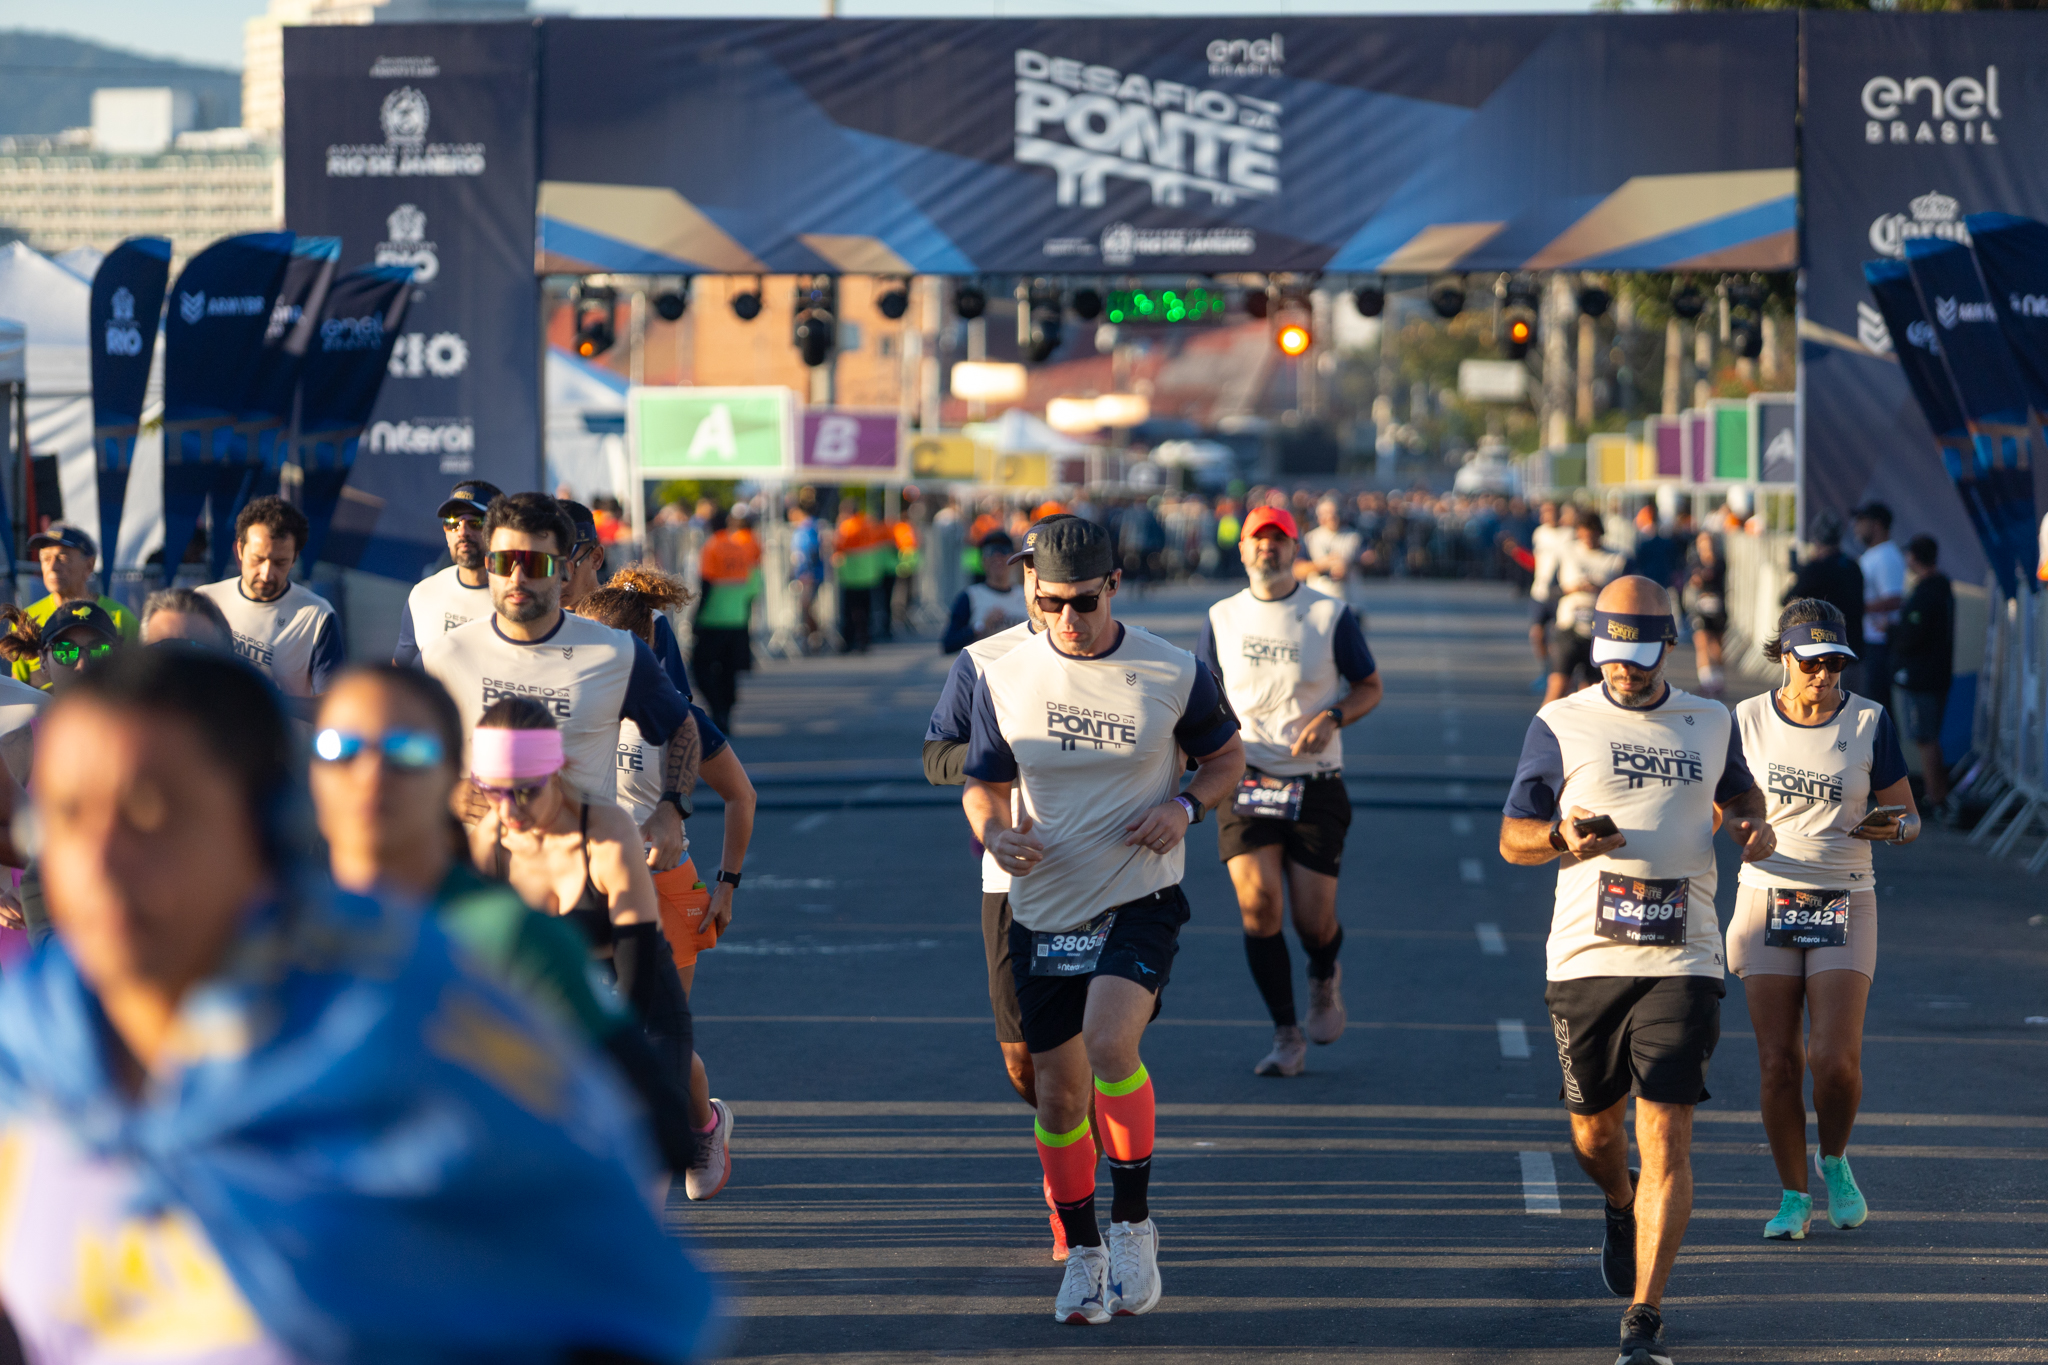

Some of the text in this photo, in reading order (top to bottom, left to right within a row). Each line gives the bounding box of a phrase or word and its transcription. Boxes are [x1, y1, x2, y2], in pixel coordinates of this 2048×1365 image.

[1207, 33, 1285, 64] enel
[1015, 48, 1239, 122] DESAFIO
[1861, 64, 2002, 121] enel
[1014, 78, 1284, 194] PONTE
[1865, 120, 1998, 145] BRASIL
[1868, 213, 1973, 260] Coron
[105, 327, 143, 357] RIO
[687, 402, 738, 462] A
[812, 414, 861, 463] B
[1608, 623, 1639, 640] PONTE
[1811, 631, 1838, 642] PONTE
[482, 677, 555, 697] DESAFIO
[1046, 701, 1120, 723] DESAFIO
[1047, 710, 1137, 745] PONTE
[1610, 742, 1687, 759] DESAFIO
[1612, 750, 1703, 782] PONTE
[1768, 762, 1843, 786] DESAFIO DA
[1768, 770, 1843, 803] PONTE
[1618, 900, 1674, 921] 3499
[1784, 909, 1835, 926] 3342
[1051, 934, 1098, 952] 3805
